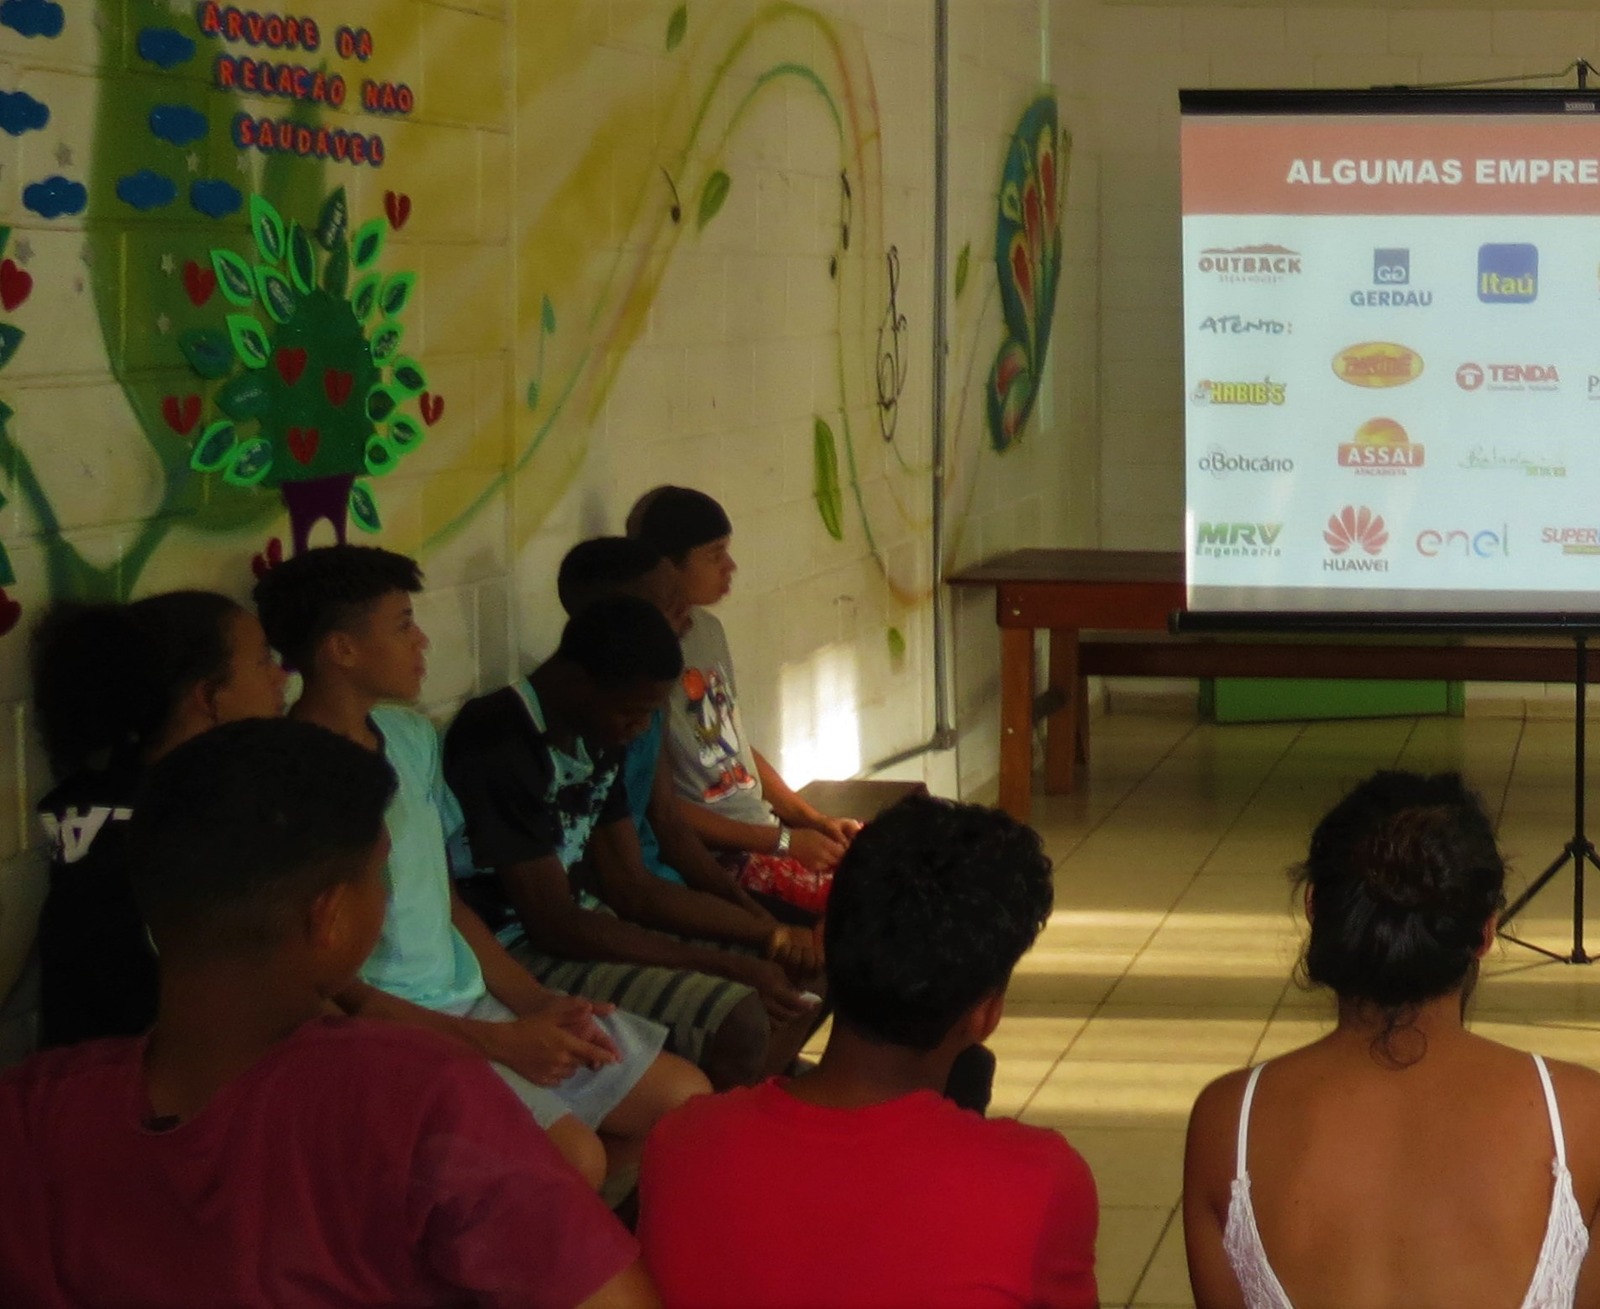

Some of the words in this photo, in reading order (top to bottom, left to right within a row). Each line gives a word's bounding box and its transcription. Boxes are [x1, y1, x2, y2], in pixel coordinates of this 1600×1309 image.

[337, 28, 373, 58] DA
[1286, 158, 1463, 185] ALGUMAS
[1198, 256, 1302, 274] OUTBACK
[1481, 272, 1534, 295] Itaú
[1350, 290, 1433, 307] GERDAU
[1487, 364, 1559, 383] TENDA
[1197, 521, 1284, 546] MRV
[1415, 522, 1511, 558] enel
[1322, 558, 1390, 573] HUAWEI
